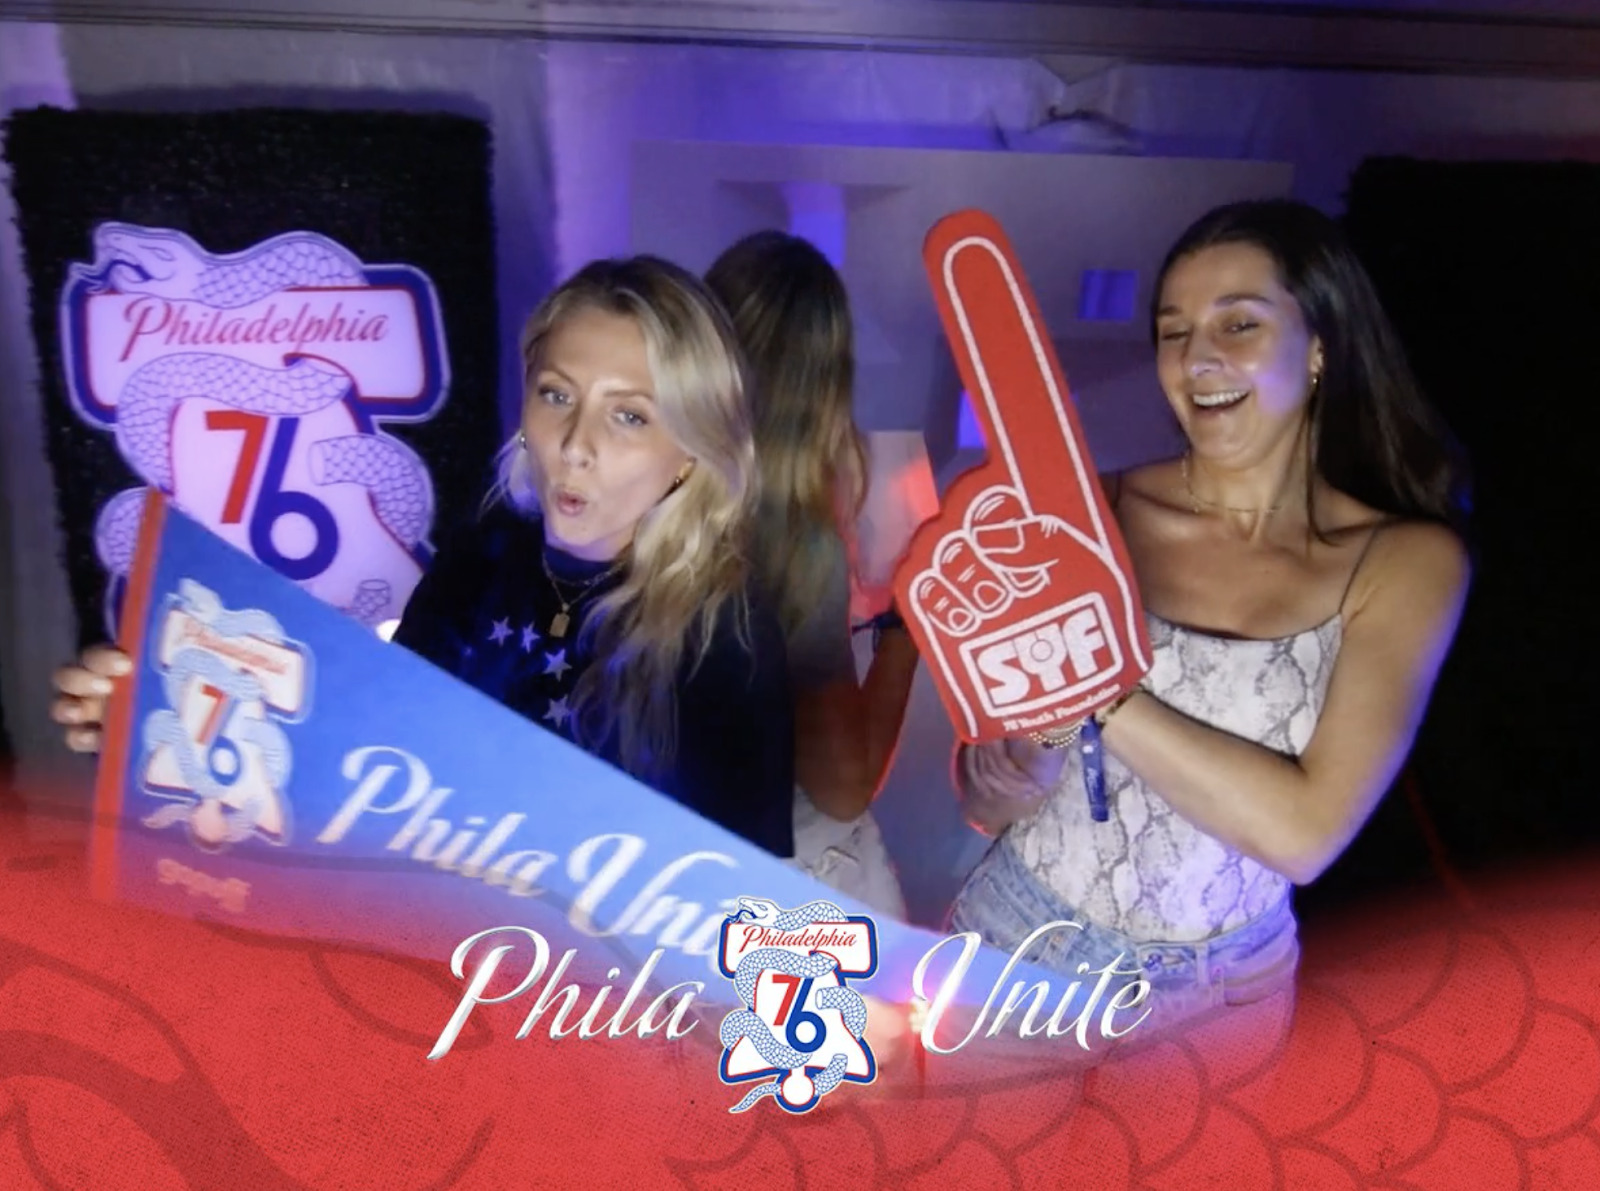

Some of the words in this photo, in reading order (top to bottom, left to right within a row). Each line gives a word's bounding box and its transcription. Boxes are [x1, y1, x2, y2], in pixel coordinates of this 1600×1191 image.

[119, 296, 389, 362] Philadelphia
[205, 410, 340, 582] 76
[976, 607, 1106, 706] SYF
[315, 745, 559, 897] Phila
[566, 832, 740, 972] Uni
